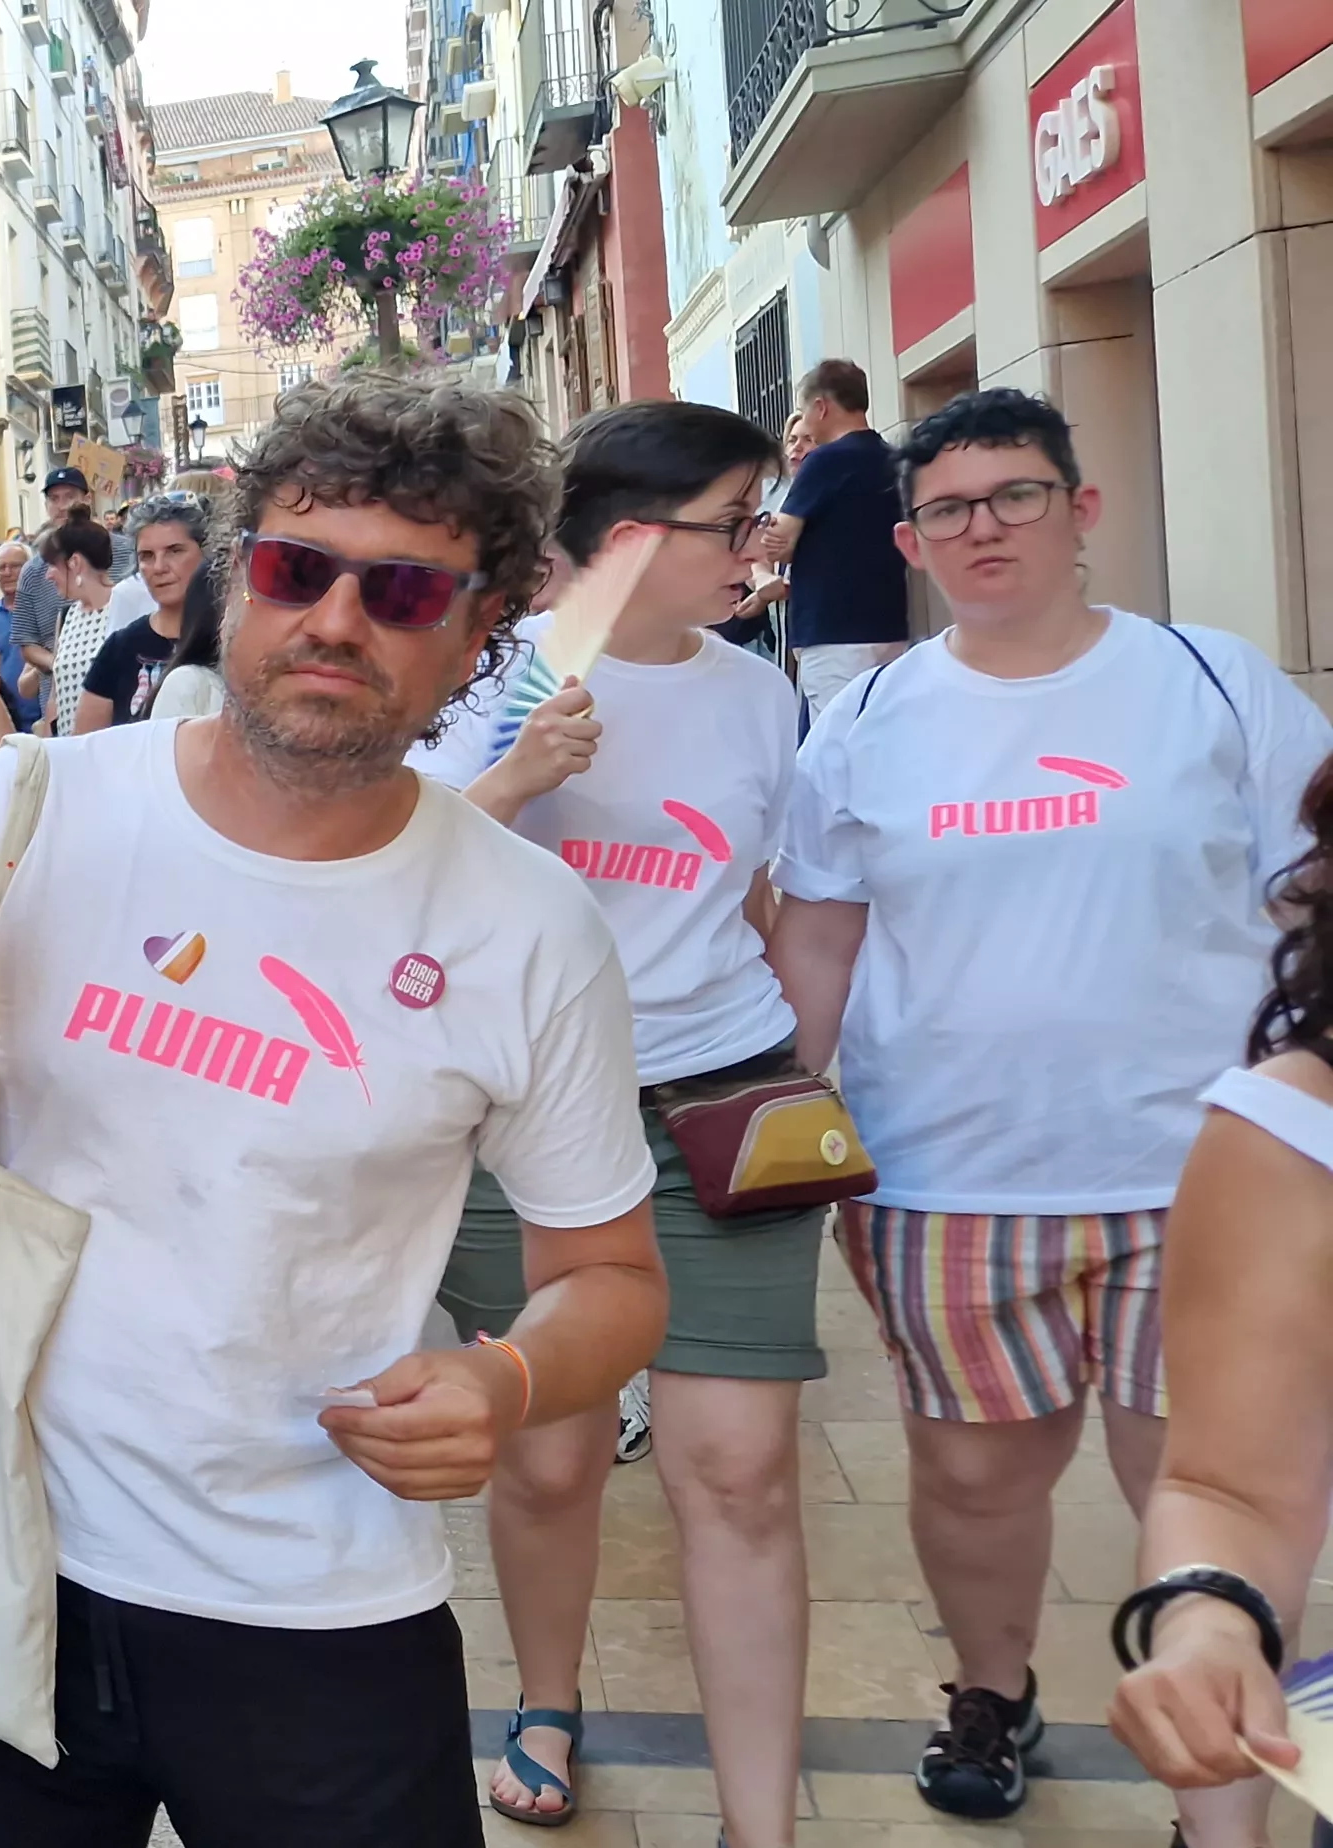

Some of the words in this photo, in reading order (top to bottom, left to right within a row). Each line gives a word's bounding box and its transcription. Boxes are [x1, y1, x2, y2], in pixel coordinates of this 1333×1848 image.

[1035, 65, 1119, 206] GAES
[929, 791, 1098, 839] PLUMA
[561, 839, 702, 891] PLUMA
[395, 973, 434, 1003] QUEER
[403, 958, 439, 987] FURIA
[63, 982, 310, 1106] PLUMA
